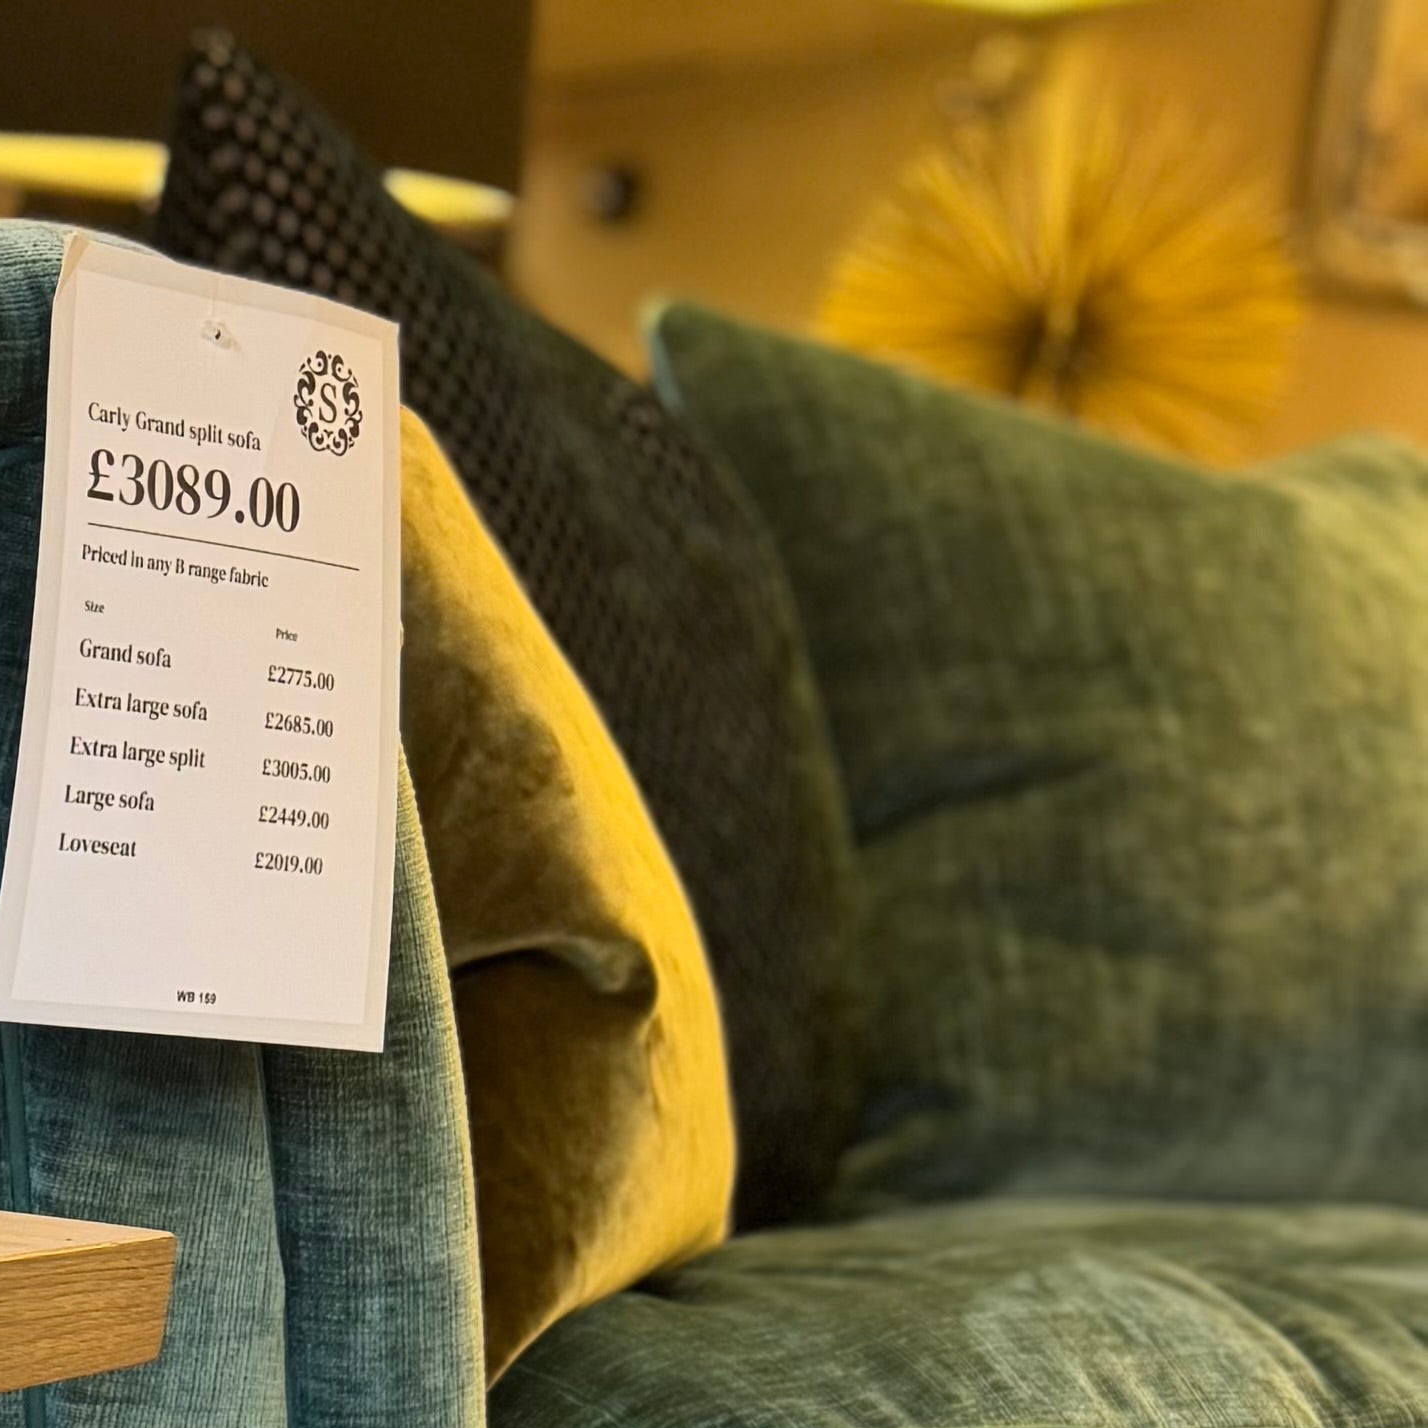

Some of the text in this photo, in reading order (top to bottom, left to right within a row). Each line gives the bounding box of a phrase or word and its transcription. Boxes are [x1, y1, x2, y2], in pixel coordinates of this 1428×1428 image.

[88, 401, 261, 452] Carly Grand split sofa
[86, 448, 300, 533] £3089.00
[81, 543, 269, 588] Priced in any B range fabric
[84, 600, 105, 614] Size
[275, 627, 298, 642] Price
[79, 638, 172, 669] Grand sofa
[267, 664, 335, 692] £2775.00
[75, 687, 208, 722] Extra large sofa
[264, 711, 334, 738] £2685.00
[69, 735, 205, 772] Extra large split
[261, 758, 331, 784] £3005.00
[64, 784, 155, 812] Large sofa
[258, 805, 330, 830] £2449.00
[58, 832, 137, 858] Loveseat
[254, 851, 324, 875] £2019.00
[176, 990, 196, 1003] WB
